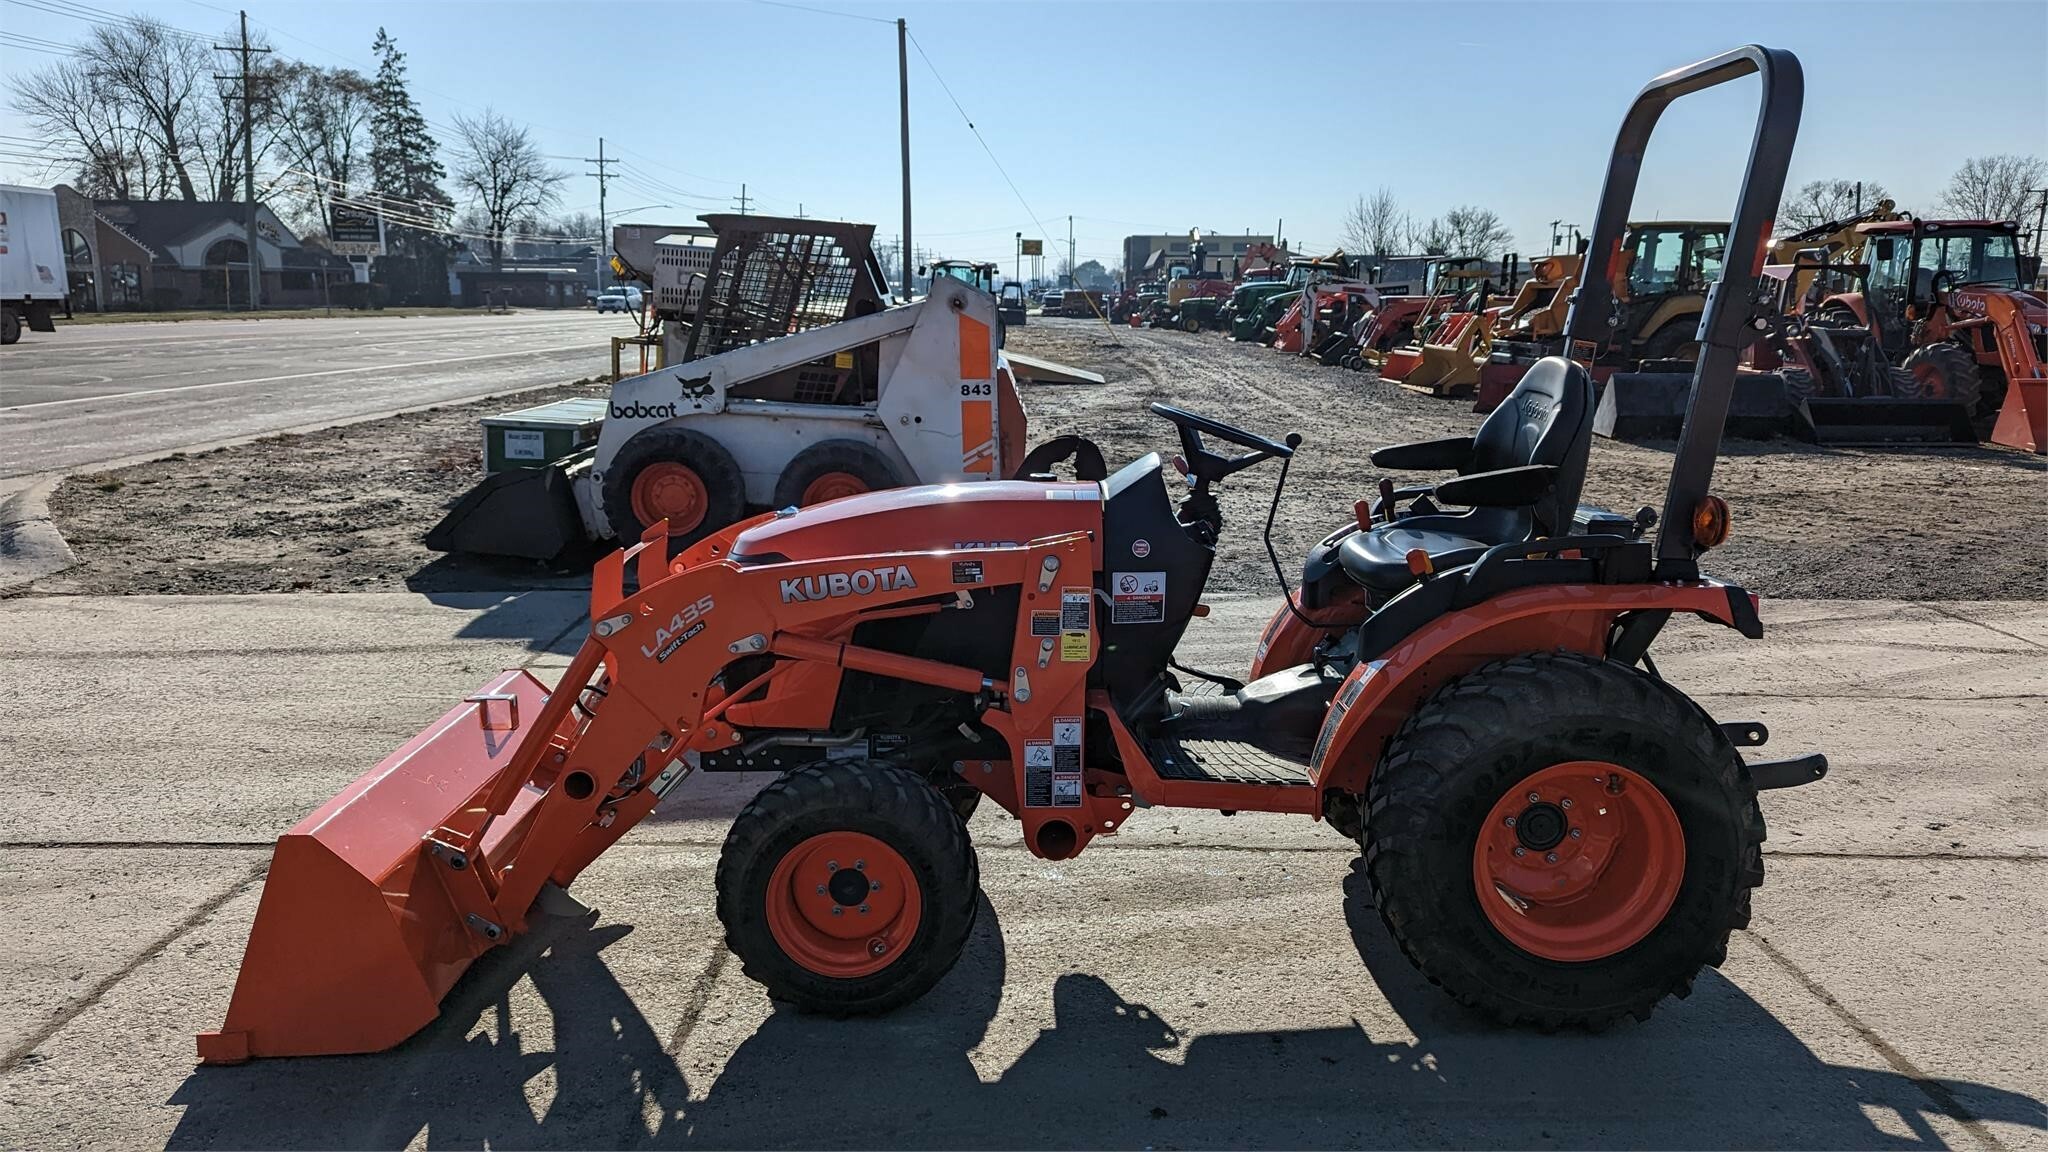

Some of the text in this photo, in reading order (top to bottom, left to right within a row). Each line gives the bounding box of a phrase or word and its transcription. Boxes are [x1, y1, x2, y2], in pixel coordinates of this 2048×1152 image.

[961, 384, 991, 396] 843
[610, 401, 678, 419] bobcat
[780, 566, 917, 603] KUBOTA
[641, 594, 715, 659] LA435
[659, 621, 706, 662] Swift-Tach
